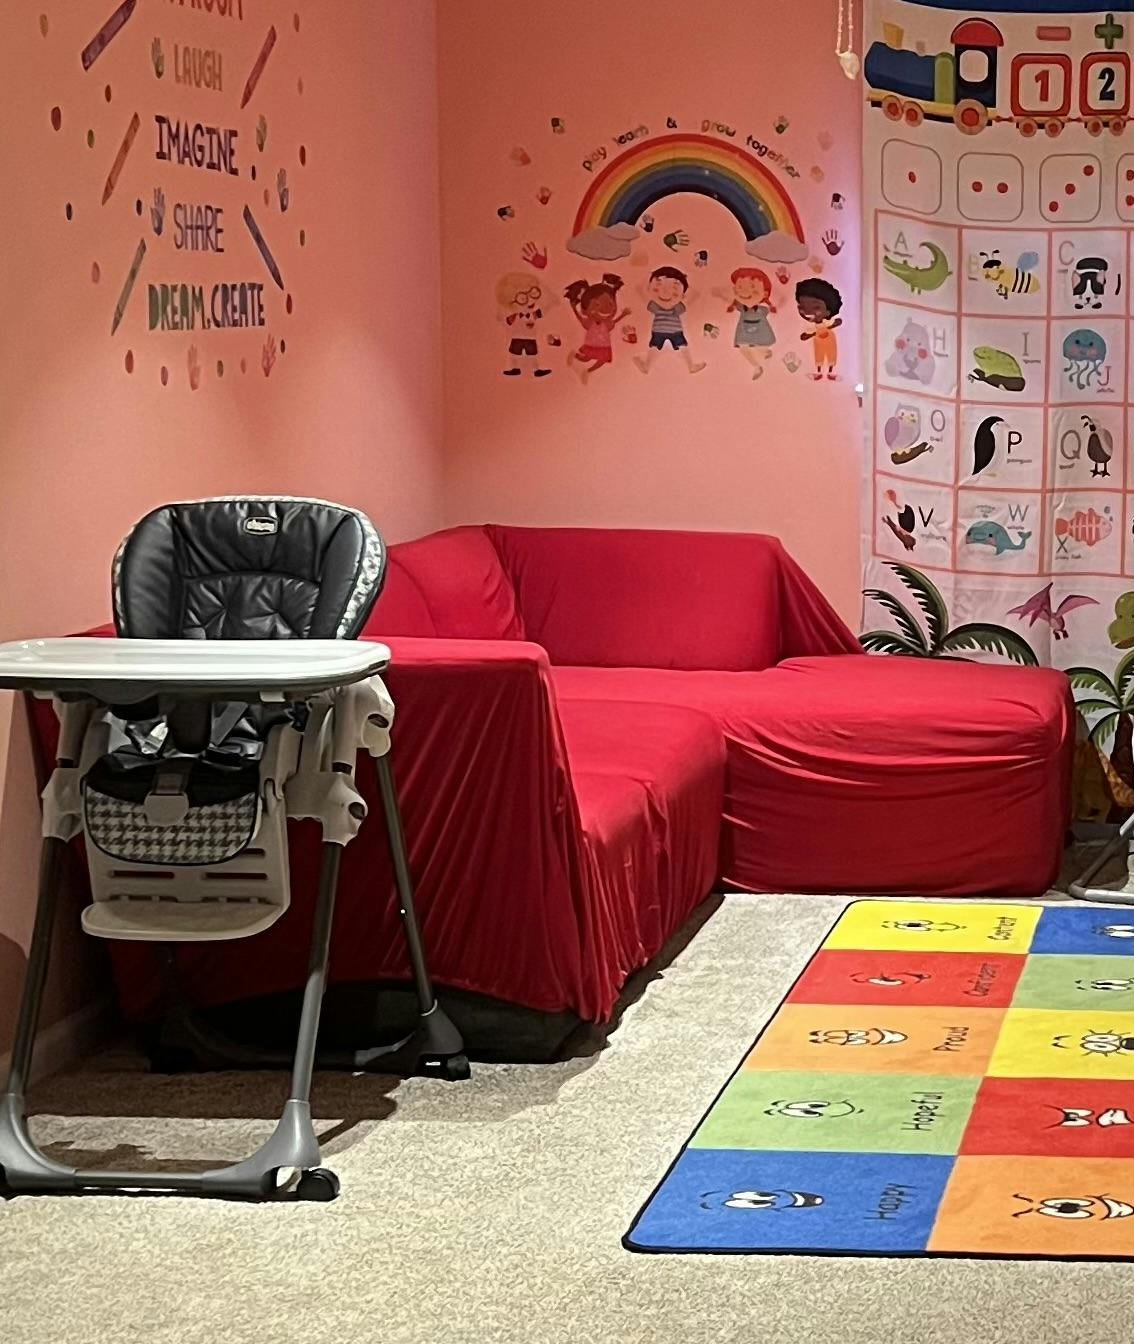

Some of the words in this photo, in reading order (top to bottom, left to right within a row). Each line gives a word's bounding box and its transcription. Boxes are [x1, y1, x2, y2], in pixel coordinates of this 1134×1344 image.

[173, 43, 223, 92] LAUGH
[1034, 69, 1050, 103] 1
[1097, 67, 1117, 102] 2
[154, 114, 240, 176] IMAGINE
[582, 146, 608, 173] play
[666, 117, 678, 130] &
[701, 118, 736, 138] grow
[746, 134, 801, 179] together
[173, 202, 225, 253] SHARE
[1007, 430, 1022, 454] P
[1060, 429, 1081, 460] Q
[918, 506, 934, 528] V
[1008, 504, 1029, 522] W
[1056, 537, 1068, 553] X
[934, 1026, 970, 1052] Proud
[901, 1091, 946, 1132] Hopeful
[863, 1182, 917, 1222] Happy
